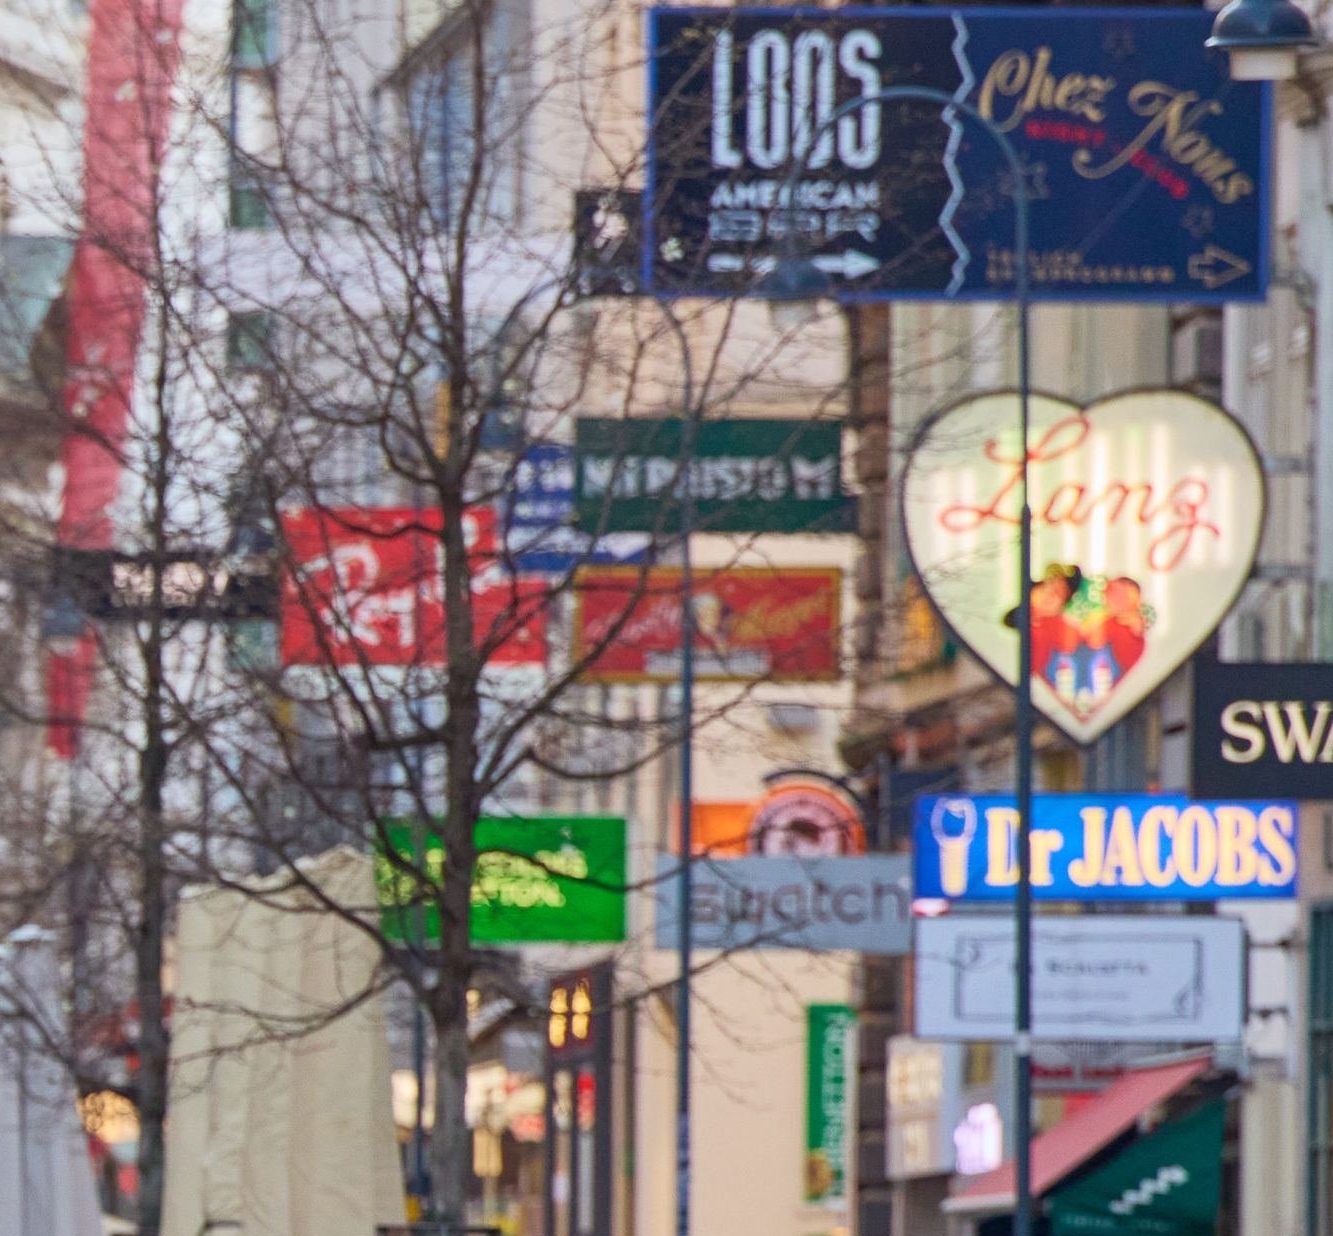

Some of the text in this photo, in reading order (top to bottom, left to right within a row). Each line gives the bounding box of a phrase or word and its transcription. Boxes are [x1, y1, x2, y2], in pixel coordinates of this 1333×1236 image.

[978, 45, 1117, 134] Chez
[1071, 79, 1254, 205] Nous
[984, 805, 1296, 887] Dr JACOBS
[689, 879, 910, 928] swatch
